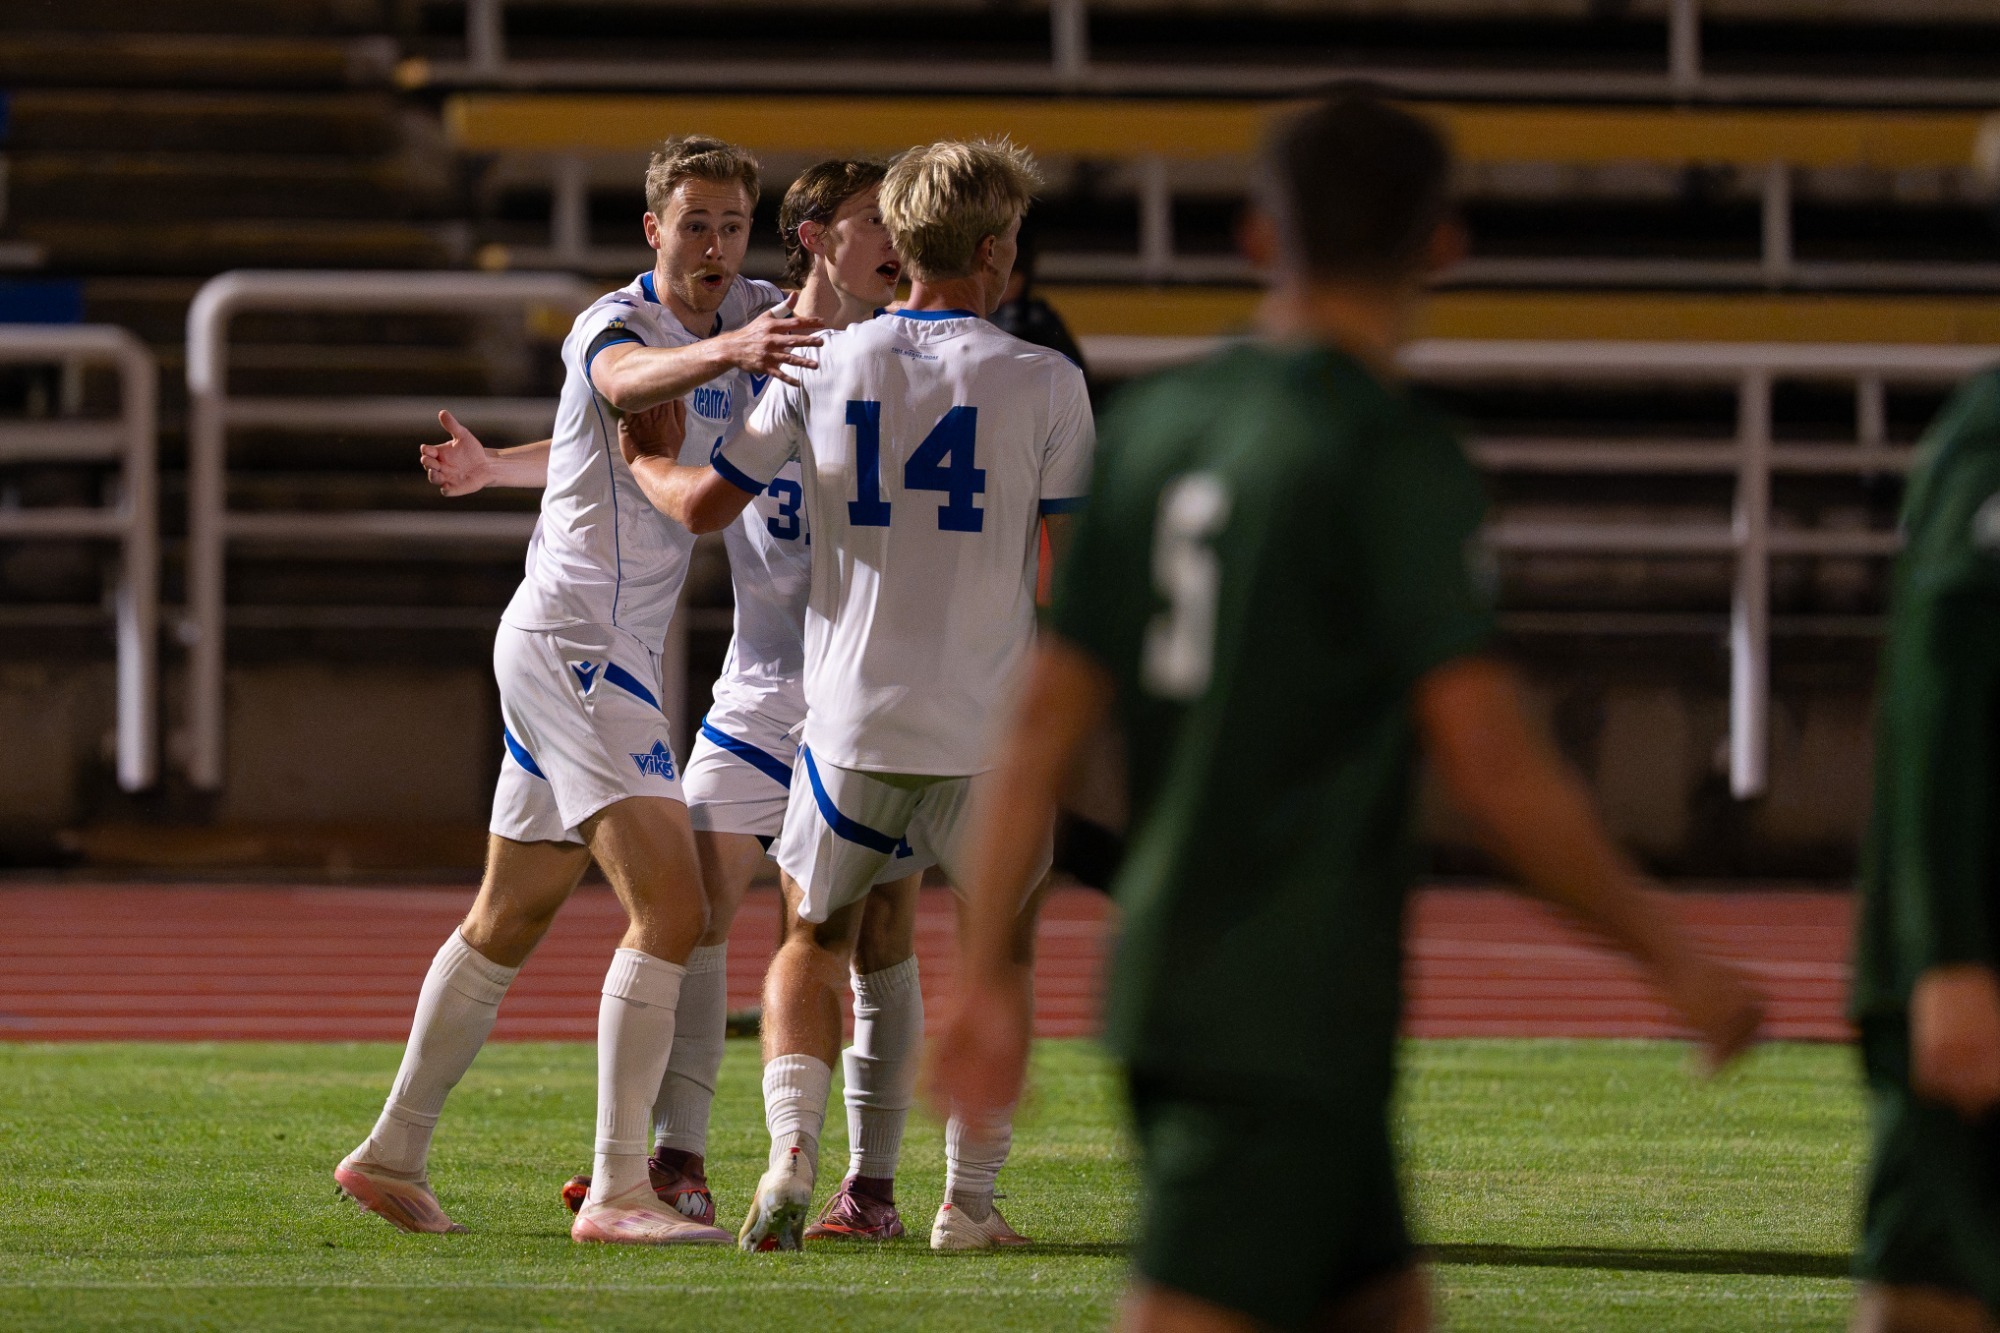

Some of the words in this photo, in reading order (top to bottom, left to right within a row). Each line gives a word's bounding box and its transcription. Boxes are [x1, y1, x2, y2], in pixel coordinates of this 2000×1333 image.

[767, 477, 811, 545] 3
[846, 400, 986, 532] 14
[1139, 472, 1231, 699] 5
